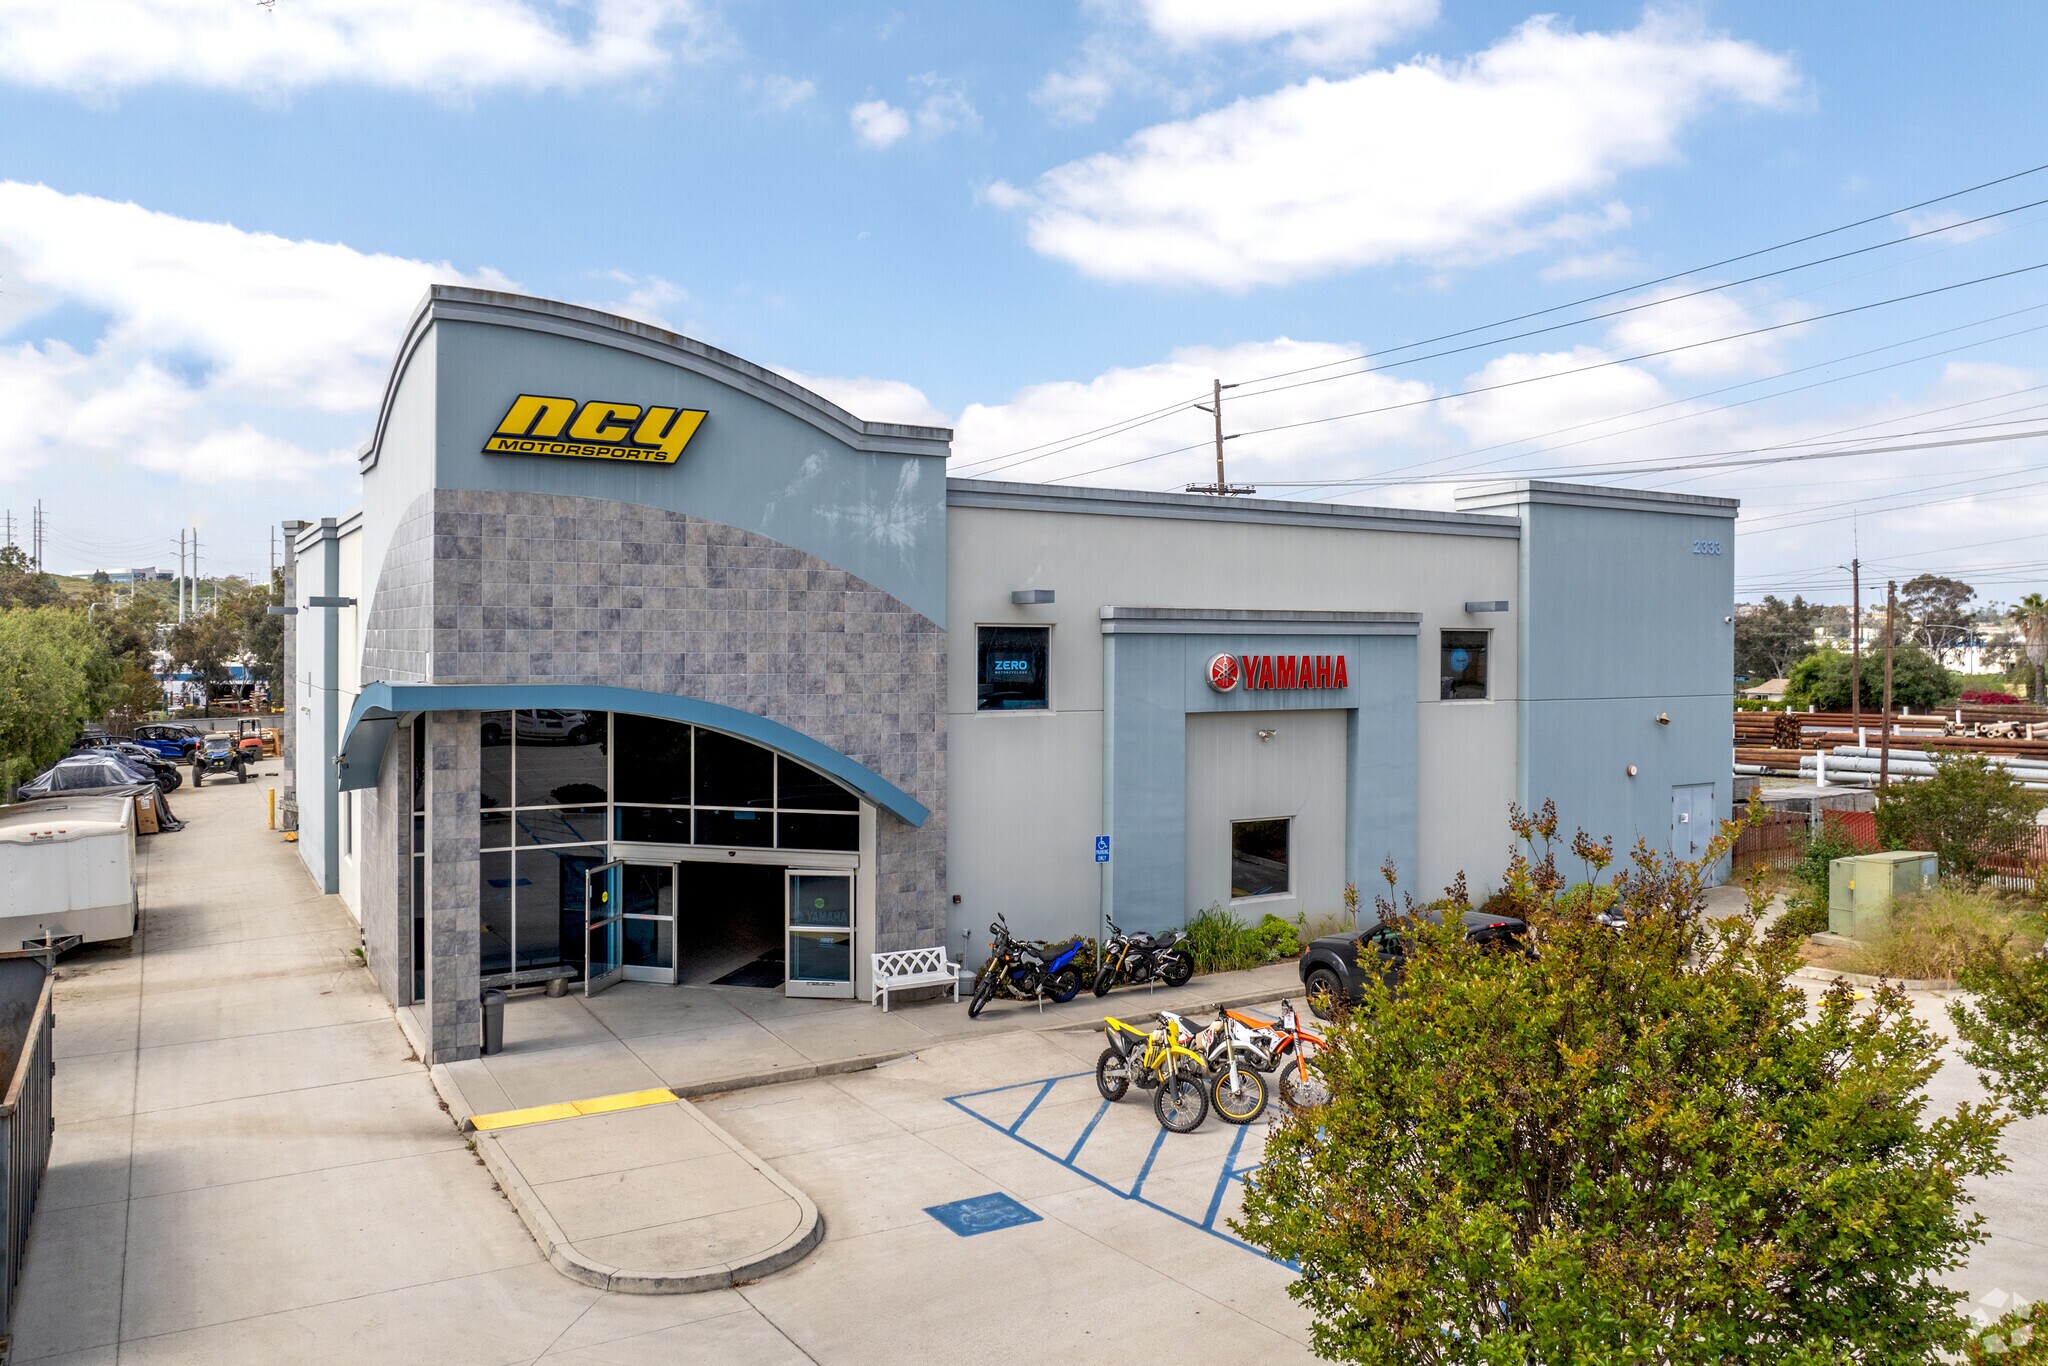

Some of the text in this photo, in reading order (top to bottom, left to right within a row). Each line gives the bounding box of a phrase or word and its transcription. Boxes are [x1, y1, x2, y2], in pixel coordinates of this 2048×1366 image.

[497, 439, 668, 461] MOTORSPORTS
[1693, 540, 1721, 555] 2333
[995, 660, 1027, 670] ZERO
[1242, 655, 1348, 690] YAMAHA
[807, 910, 848, 923] YAMAHA
